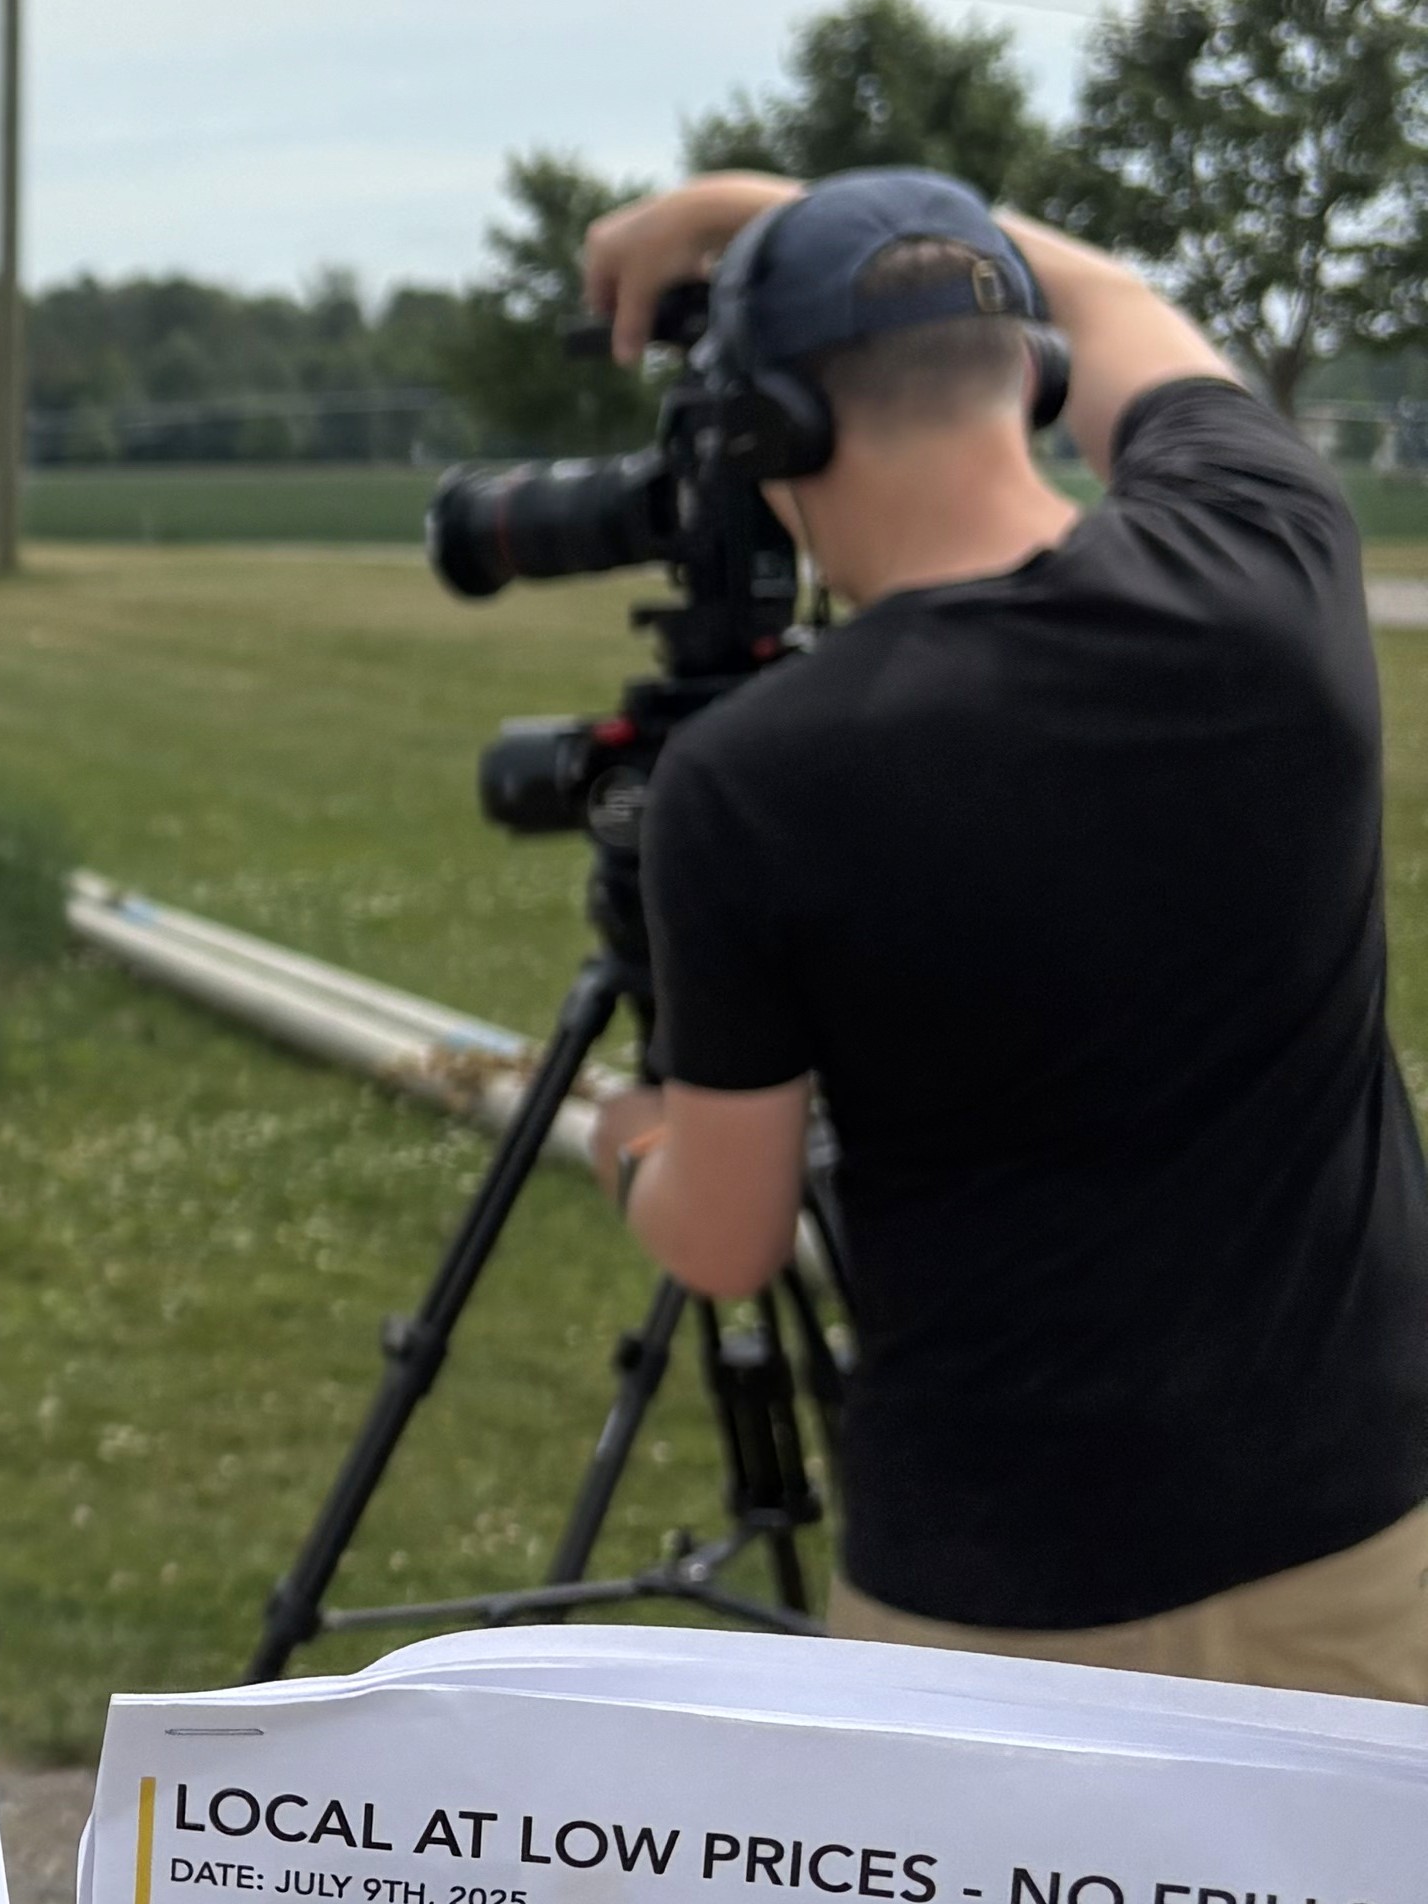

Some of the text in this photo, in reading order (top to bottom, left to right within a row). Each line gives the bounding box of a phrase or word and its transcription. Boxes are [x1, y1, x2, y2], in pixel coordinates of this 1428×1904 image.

[170, 1857, 264, 1891] DATE:
[274, 1869, 353, 1899] JULY
[174, 1783, 394, 1852] LOCAL
[412, 1808, 498, 1859] AT
[520, 1815, 681, 1875] LOW
[702, 1832, 938, 1904] PRICES
